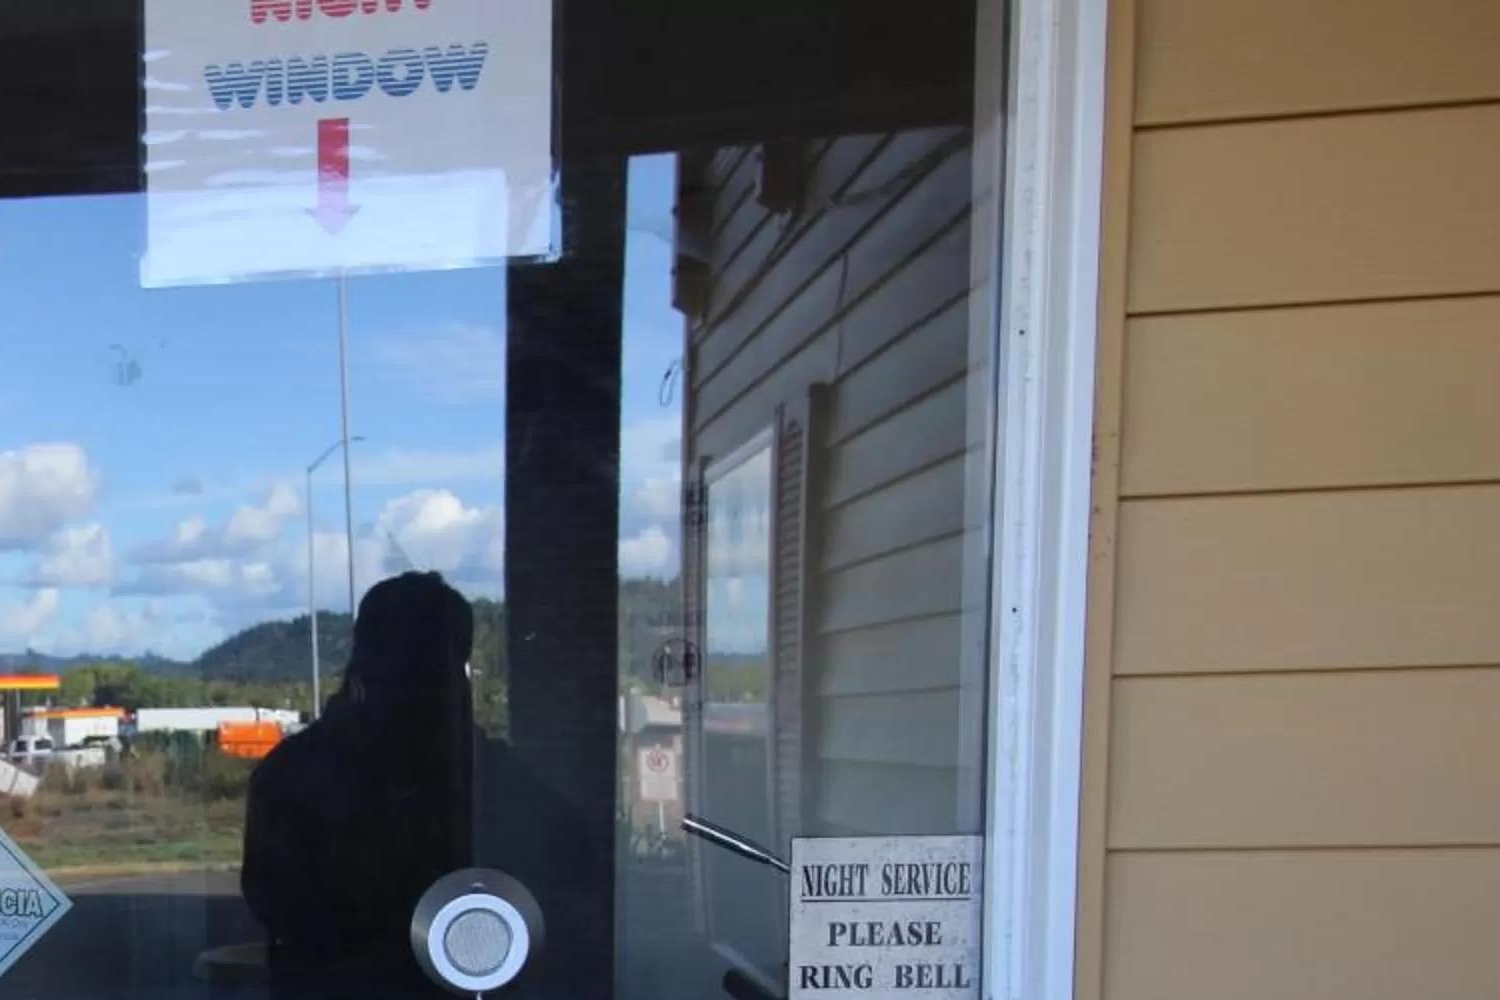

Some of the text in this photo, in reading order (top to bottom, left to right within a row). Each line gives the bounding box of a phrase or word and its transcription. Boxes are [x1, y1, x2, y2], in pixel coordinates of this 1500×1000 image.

[204, 41, 488, 110] WINDOW
[801, 862, 971, 897] NIGHT SERVICE
[827, 921, 943, 947] PLEASE
[799, 963, 971, 989] RING BELL
